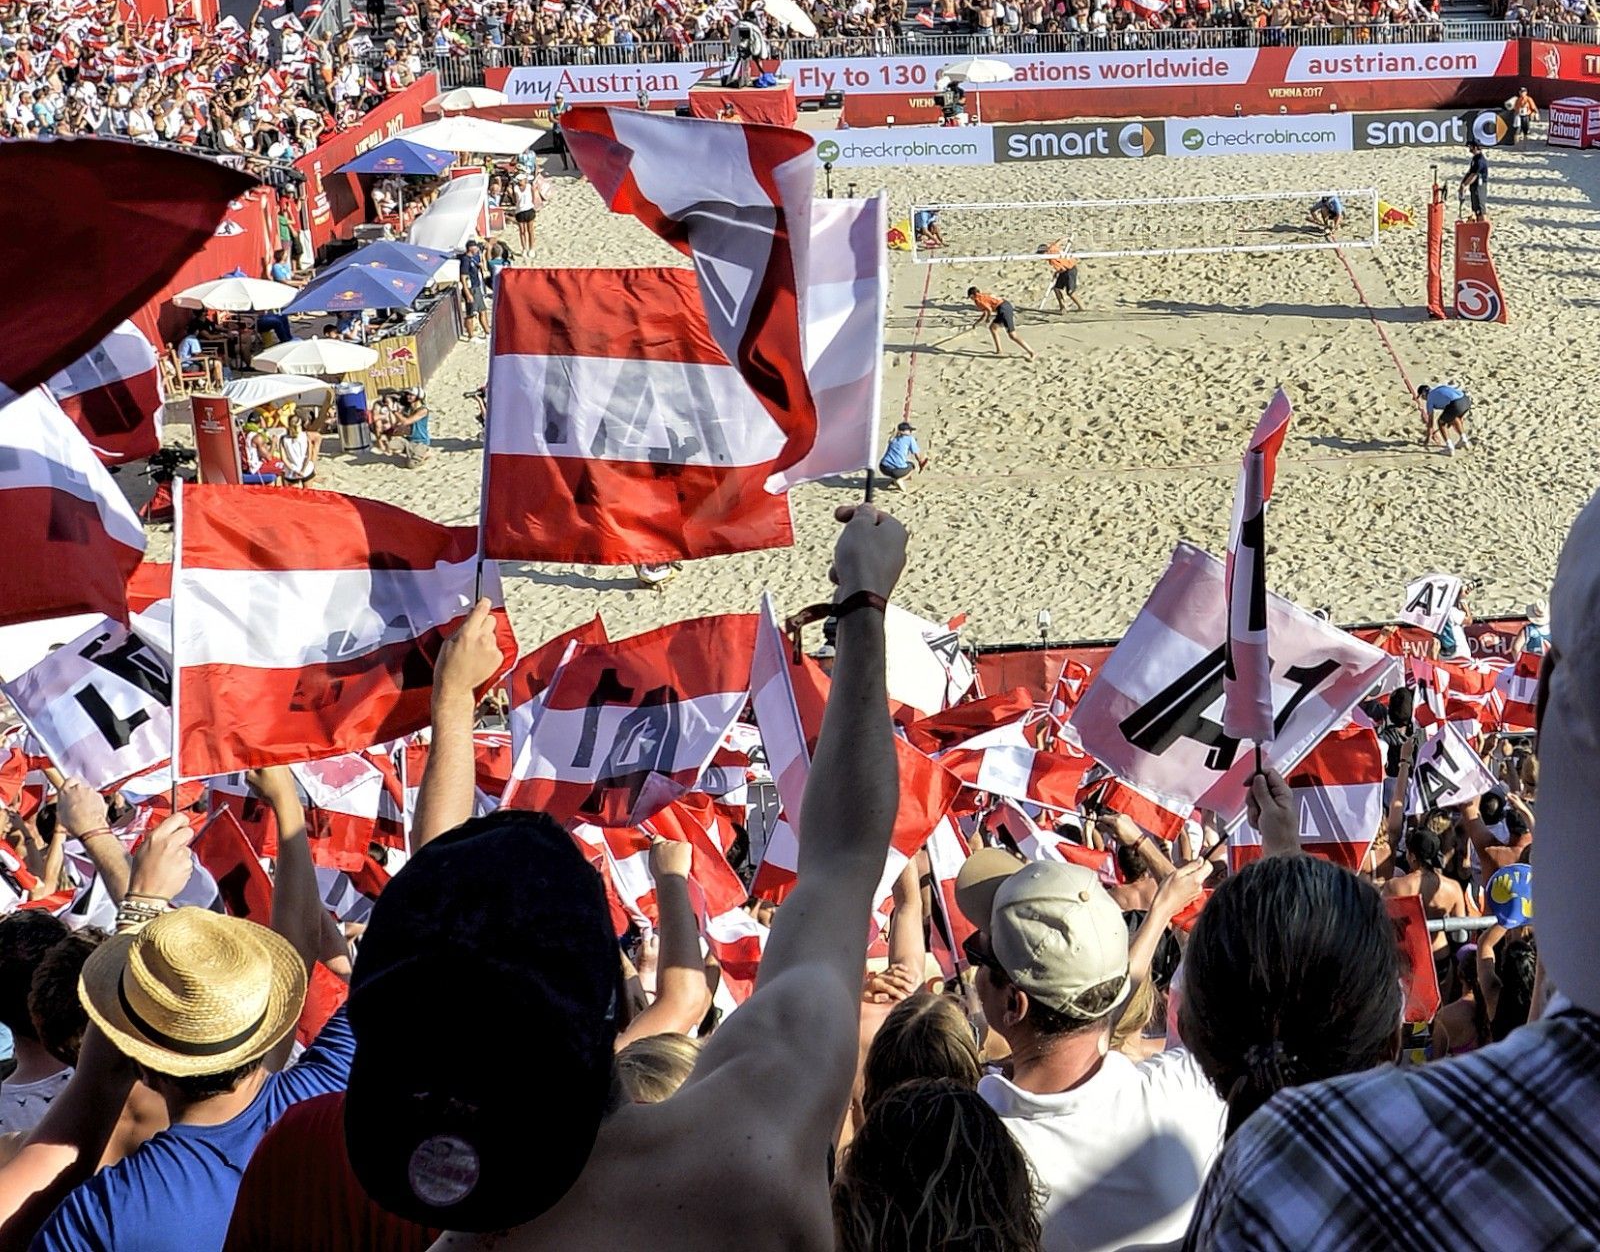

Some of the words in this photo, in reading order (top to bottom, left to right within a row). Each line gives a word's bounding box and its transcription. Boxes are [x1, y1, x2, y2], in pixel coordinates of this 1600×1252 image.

[799, 66, 835, 91] Fly
[843, 66, 870, 87] to
[880, 64, 927, 86] 130
[1099, 56, 1229, 80] worldwide
[1308, 50, 1478, 75] austrian.com
[1268, 87, 1301, 98] VIENNA
[1302, 86, 1324, 98] 2017
[1365, 111, 1466, 145] smart
[1550, 109, 1582, 124] Kronen
[1007, 127, 1109, 156] smart
[1207, 129, 1336, 146] checkrobin.com
[1550, 121, 1582, 138] Zeitung
[842, 139, 978, 159] checkrobin.com
[1406, 582, 1449, 617] A1
[1416, 739, 1461, 809] A1
